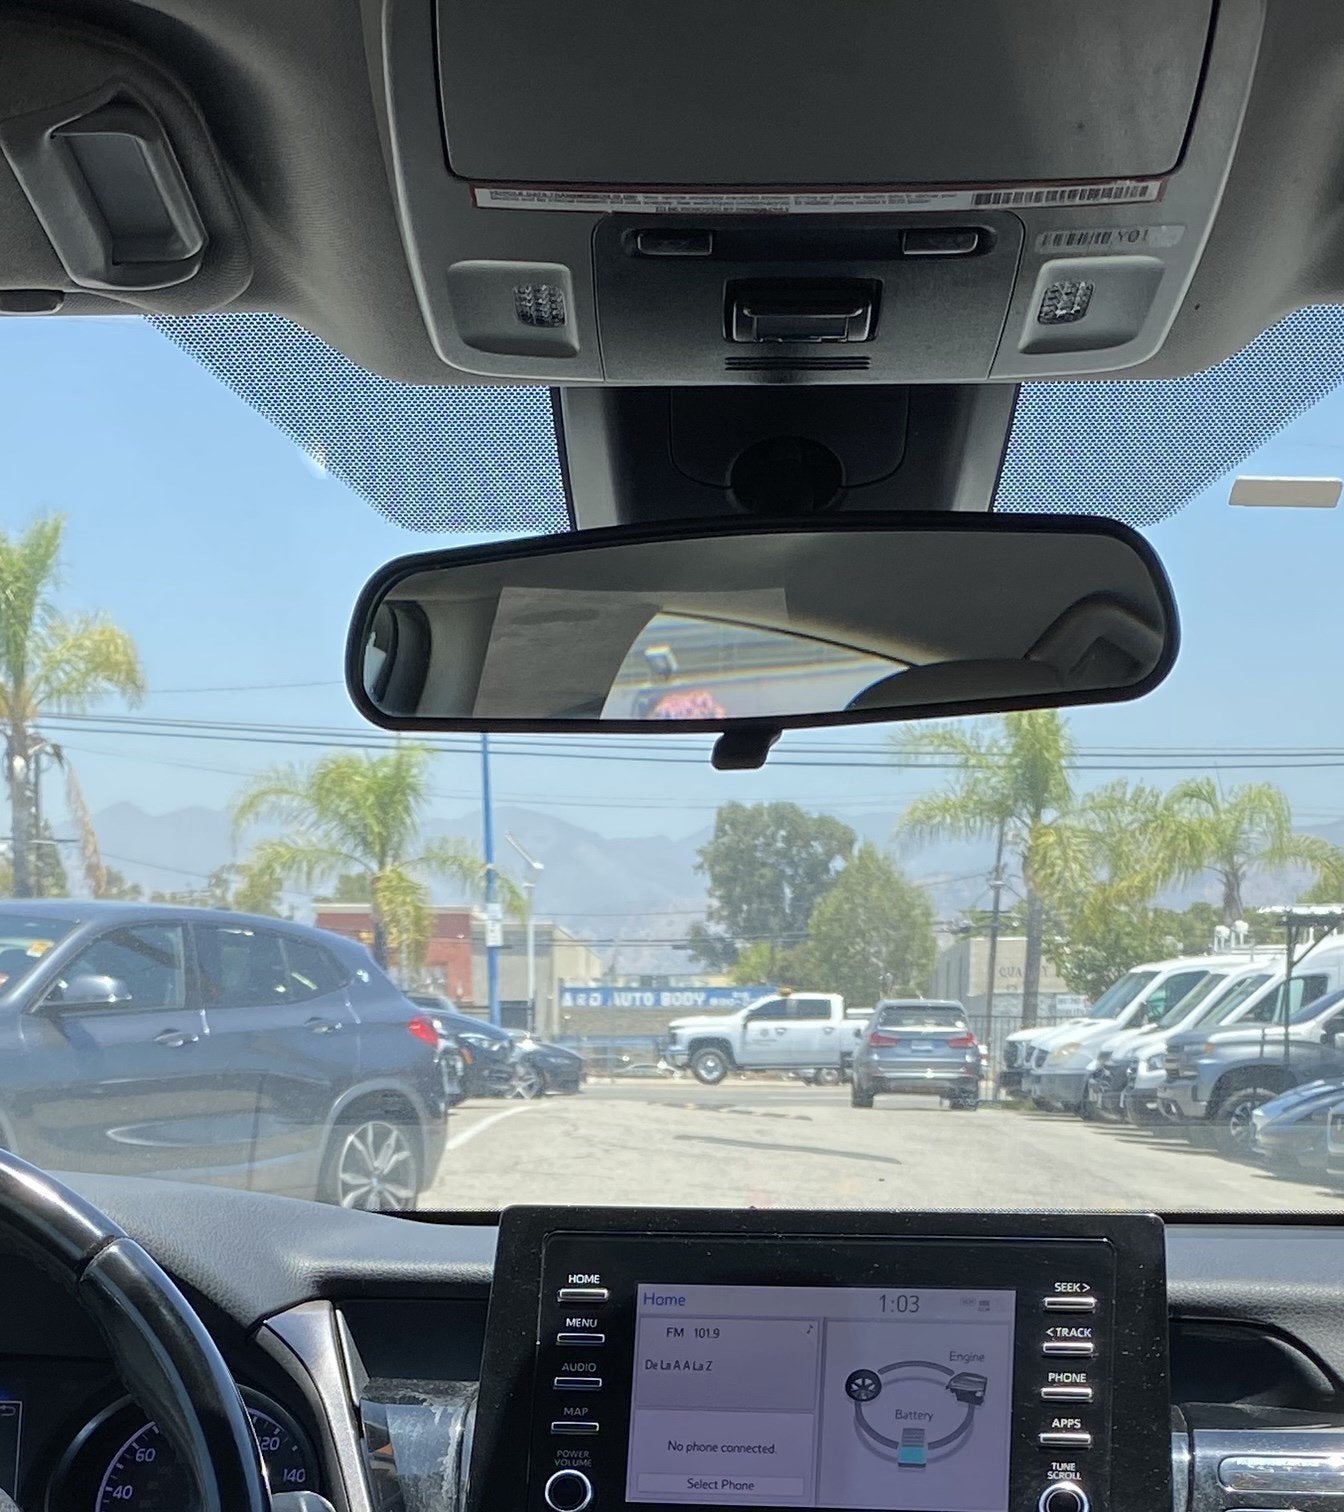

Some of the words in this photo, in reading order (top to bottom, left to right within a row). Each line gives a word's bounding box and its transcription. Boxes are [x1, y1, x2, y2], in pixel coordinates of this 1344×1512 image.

[999, 966, 1047, 978] QUAY
[612, 991, 654, 1007] AUTO
[659, 991, 705, 1007] BODY
[568, 1273, 600, 1284] HOME
[1054, 1282, 1081, 1292] SEEK
[642, 1292, 686, 1307] Home
[878, 1294, 920, 1313] 1:03
[565, 1317, 598, 1328] MENU
[666, 1327, 684, 1338] FM
[694, 1327, 720, 1339] 101.9
[1056, 1327, 1092, 1338] TRACK
[949, 1351, 985, 1364] Engine
[561, 1362, 597, 1372] AUDIO
[660, 1360, 671, 1370] La
[673, 1360, 681, 1370] A
[682, 1360, 691, 1370] A
[692, 1361, 704, 1371] La
[705, 1361, 713, 1371] Z
[1047, 1372, 1087, 1383] PHONE
[563, 1407, 589, 1416] MAP
[895, 1409, 934, 1422] Battery
[1051, 1418, 1082, 1429] APPS
[668, 1440, 684, 1451] No
[686, 1441, 718, 1454] phone
[720, 1442, 777, 1455] connected.
[135, 1448, 156, 1462] 60
[557, 1449, 590, 1458] POWER
[554, 1458, 592, 1467] VOLUME
[1051, 1462, 1076, 1471] TUNE
[283, 1468, 305, 1483] 140
[1047, 1471, 1082, 1481] SCROLL
[687, 1478, 719, 1490] Select
[721, 1479, 755, 1491] Phone
[112, 1484, 133, 1499] 40
